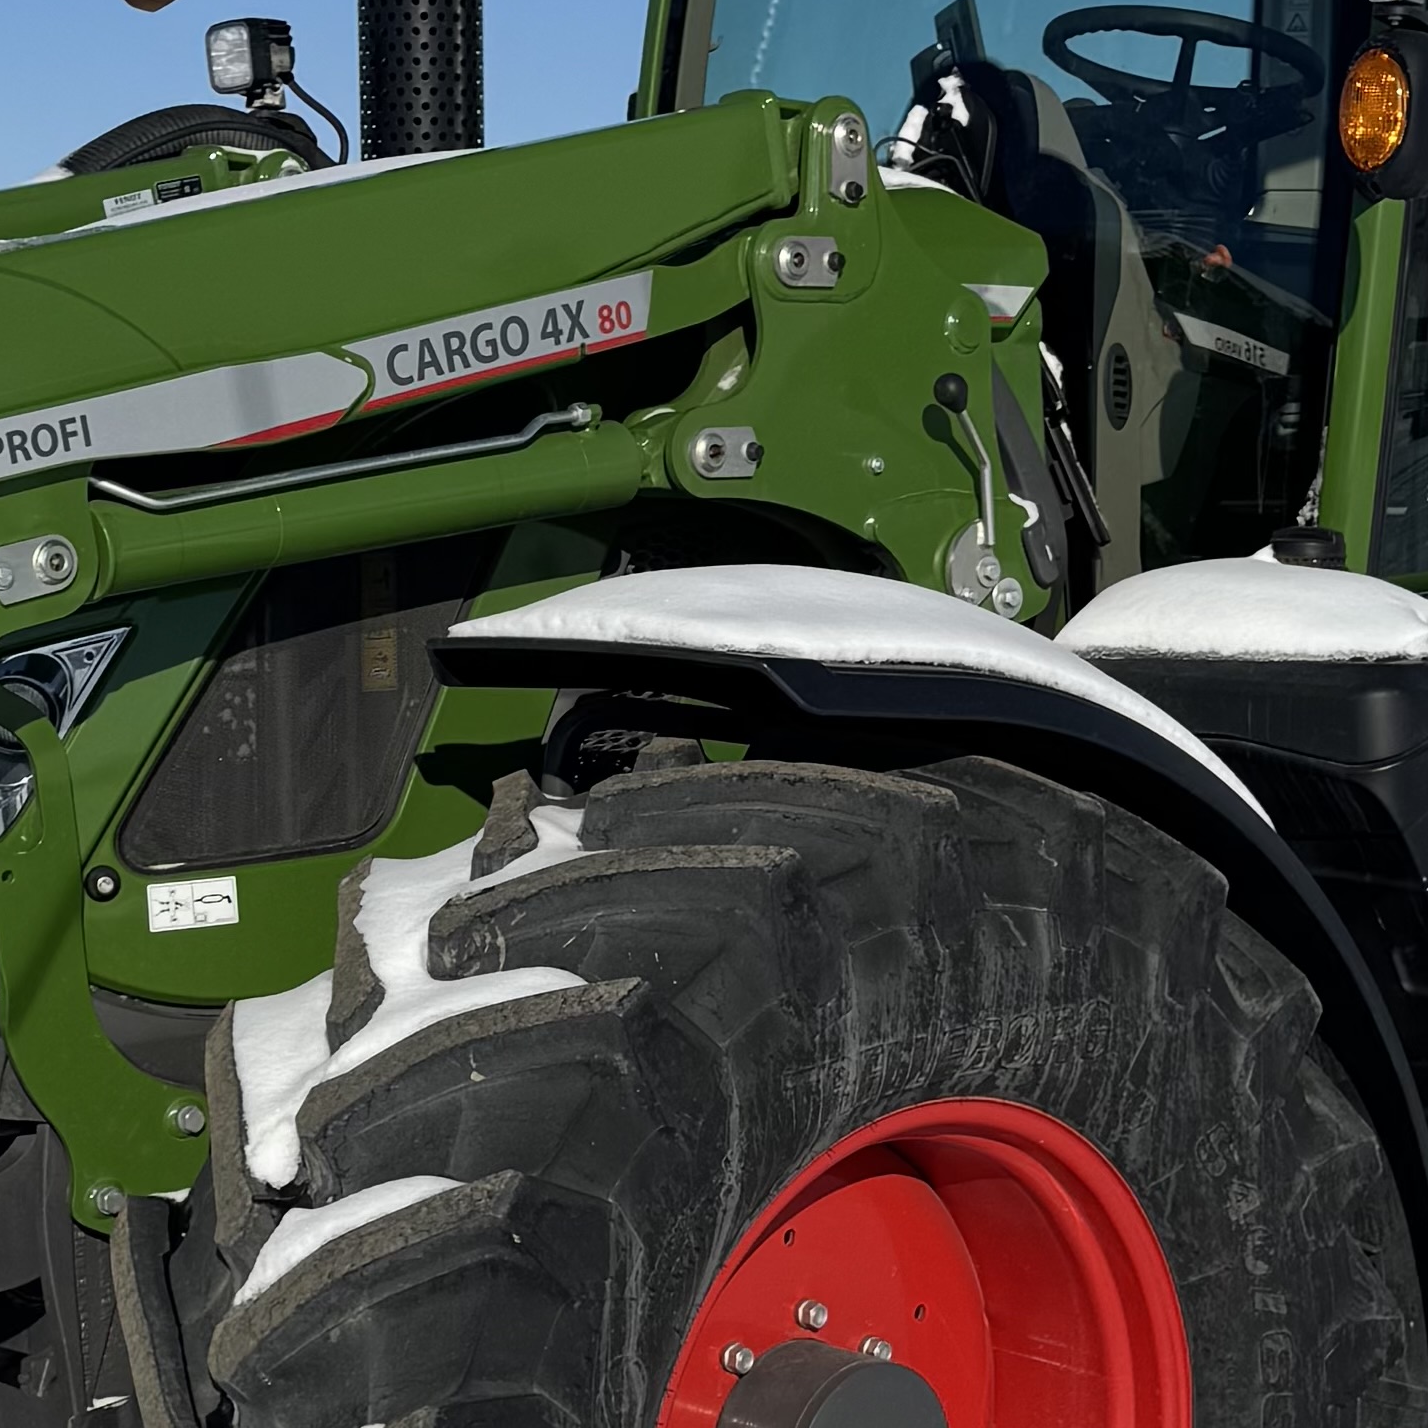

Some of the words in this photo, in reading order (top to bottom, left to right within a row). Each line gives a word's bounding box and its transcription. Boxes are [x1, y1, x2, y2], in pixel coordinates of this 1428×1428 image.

[386, 315, 529, 386] CARGO
[540, 299, 590, 346] 4X
[597, 300, 632, 334] 80
